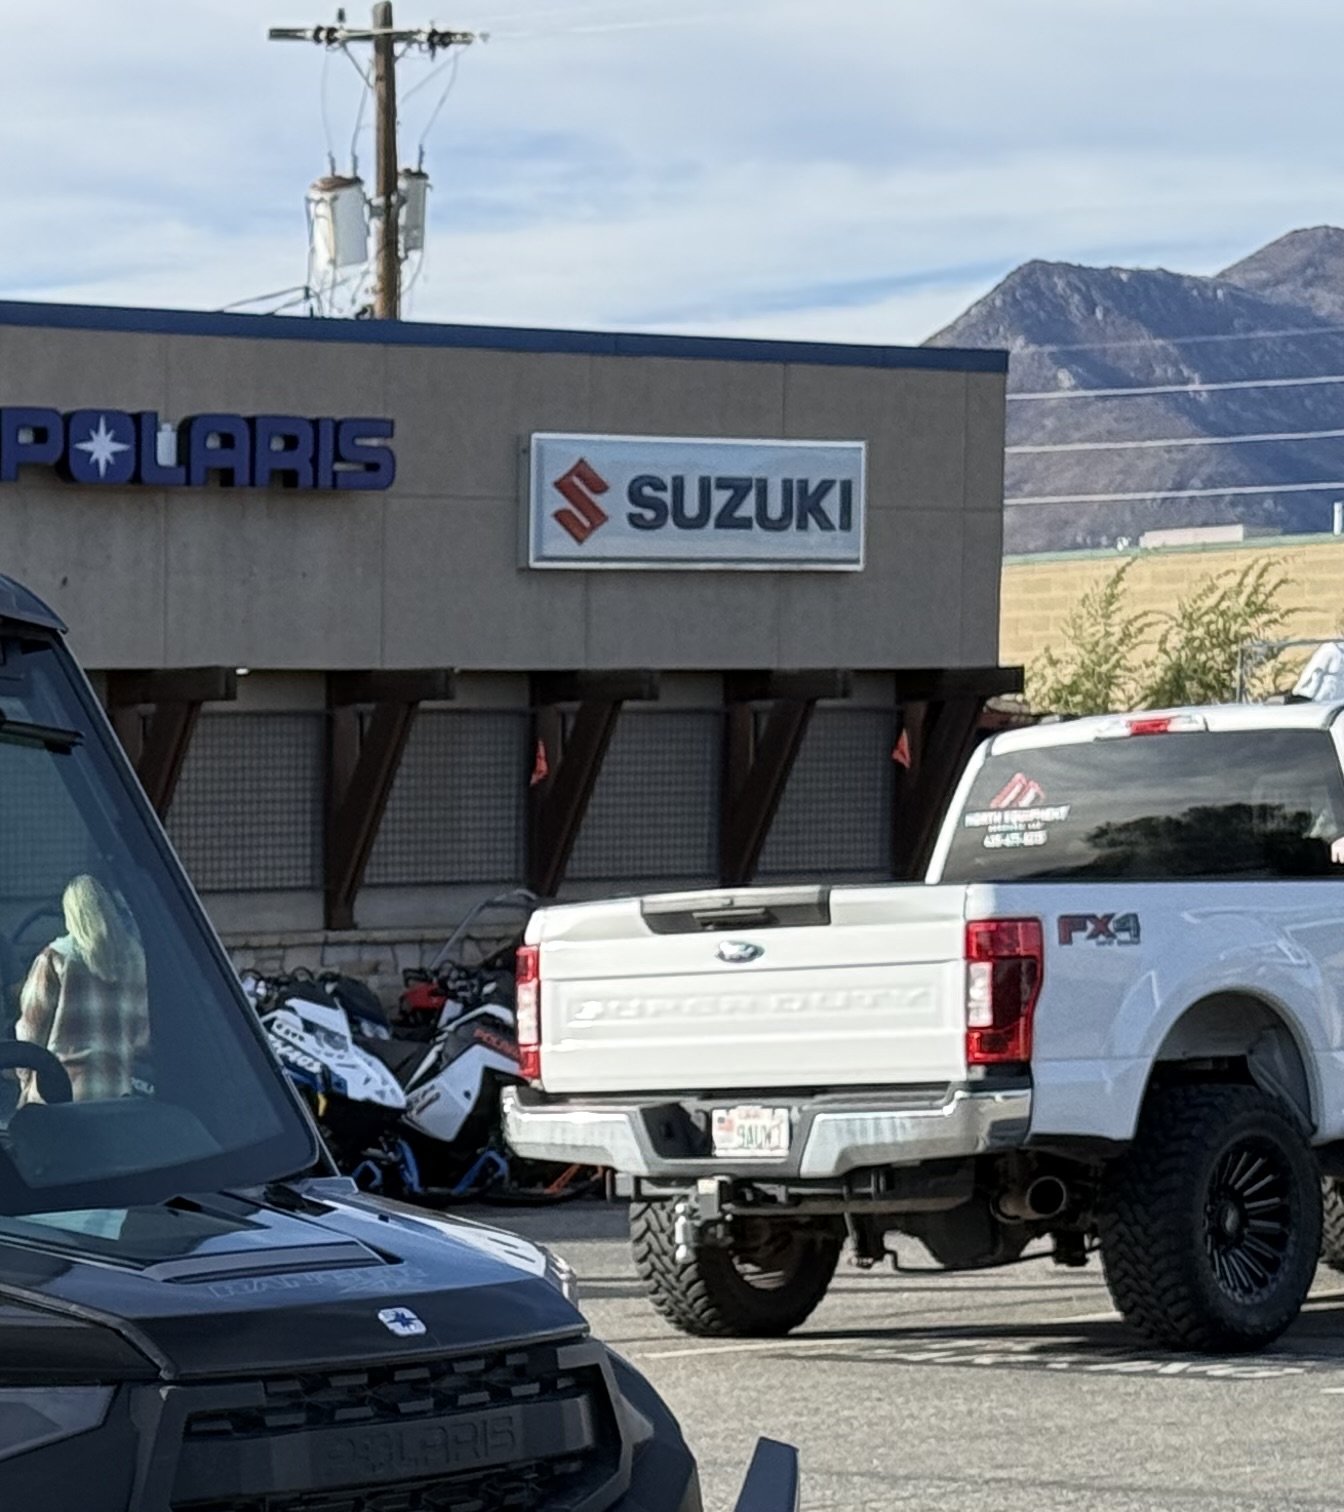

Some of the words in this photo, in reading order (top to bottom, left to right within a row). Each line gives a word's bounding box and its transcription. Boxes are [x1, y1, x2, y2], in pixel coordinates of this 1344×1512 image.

[626, 475, 853, 533] SUZUKI
[1057, 912, 1141, 946] FX4
[323, 1415, 517, 1475] POLARIS
